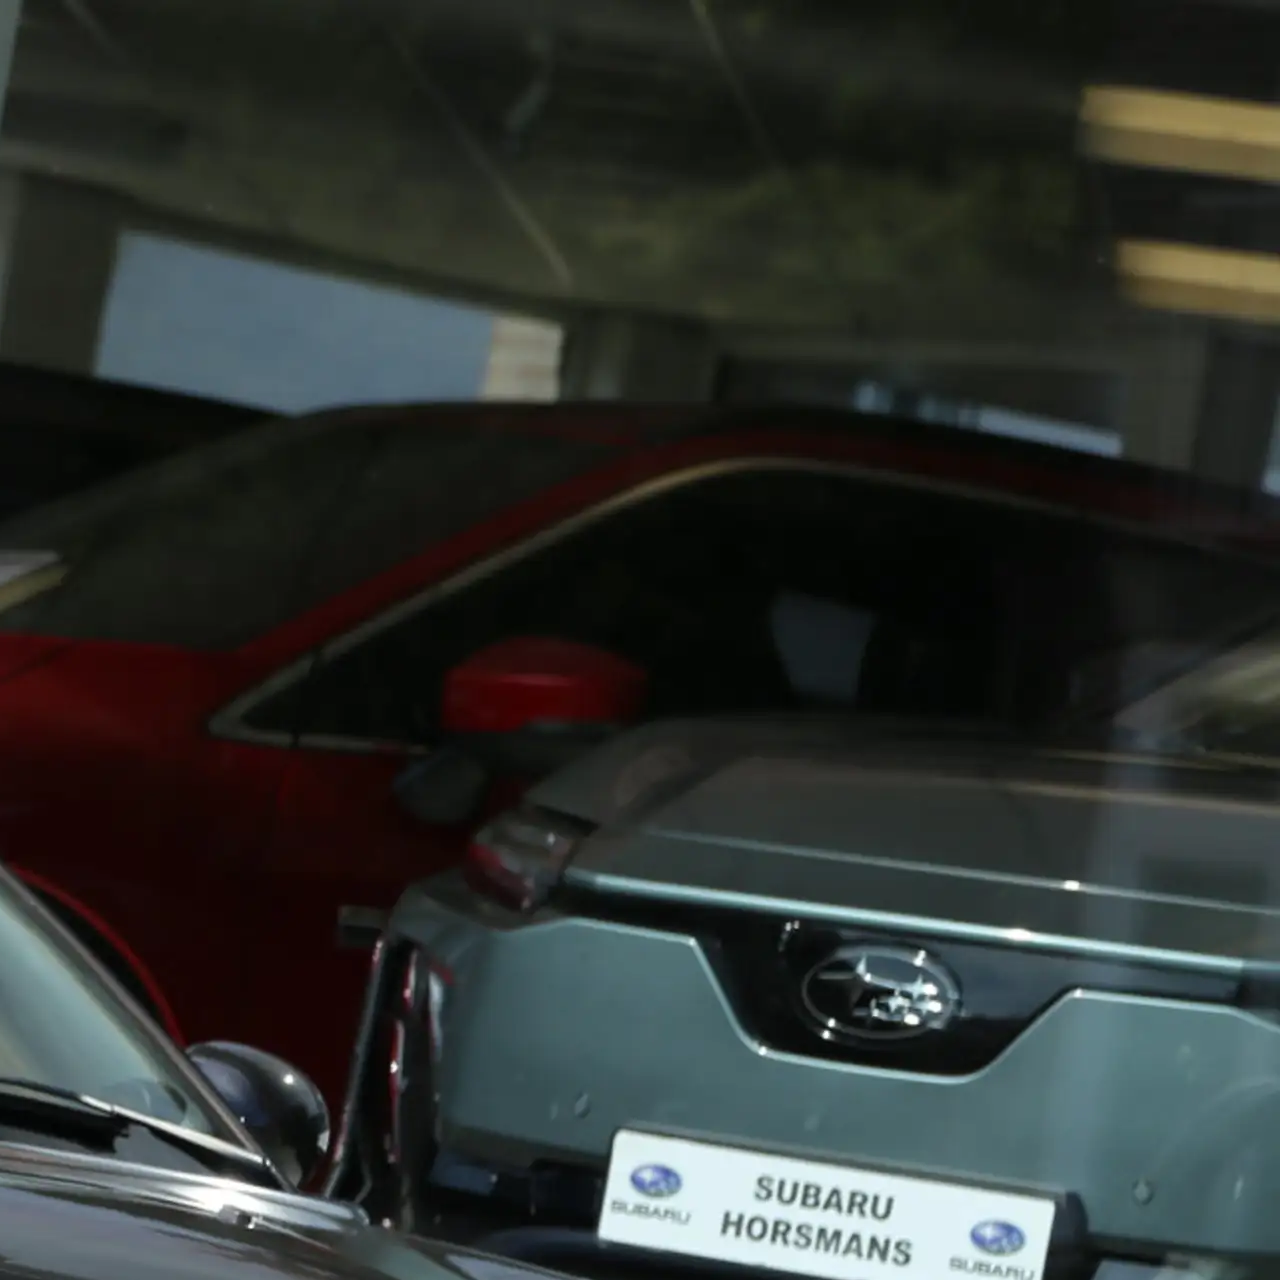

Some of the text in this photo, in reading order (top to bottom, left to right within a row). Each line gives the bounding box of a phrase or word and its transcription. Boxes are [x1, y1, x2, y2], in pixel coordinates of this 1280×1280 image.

[609, 1199, 692, 1226] SUBARU
[754, 1174, 895, 1222] SUBARU
[720, 1211, 913, 1267] HORSMANS
